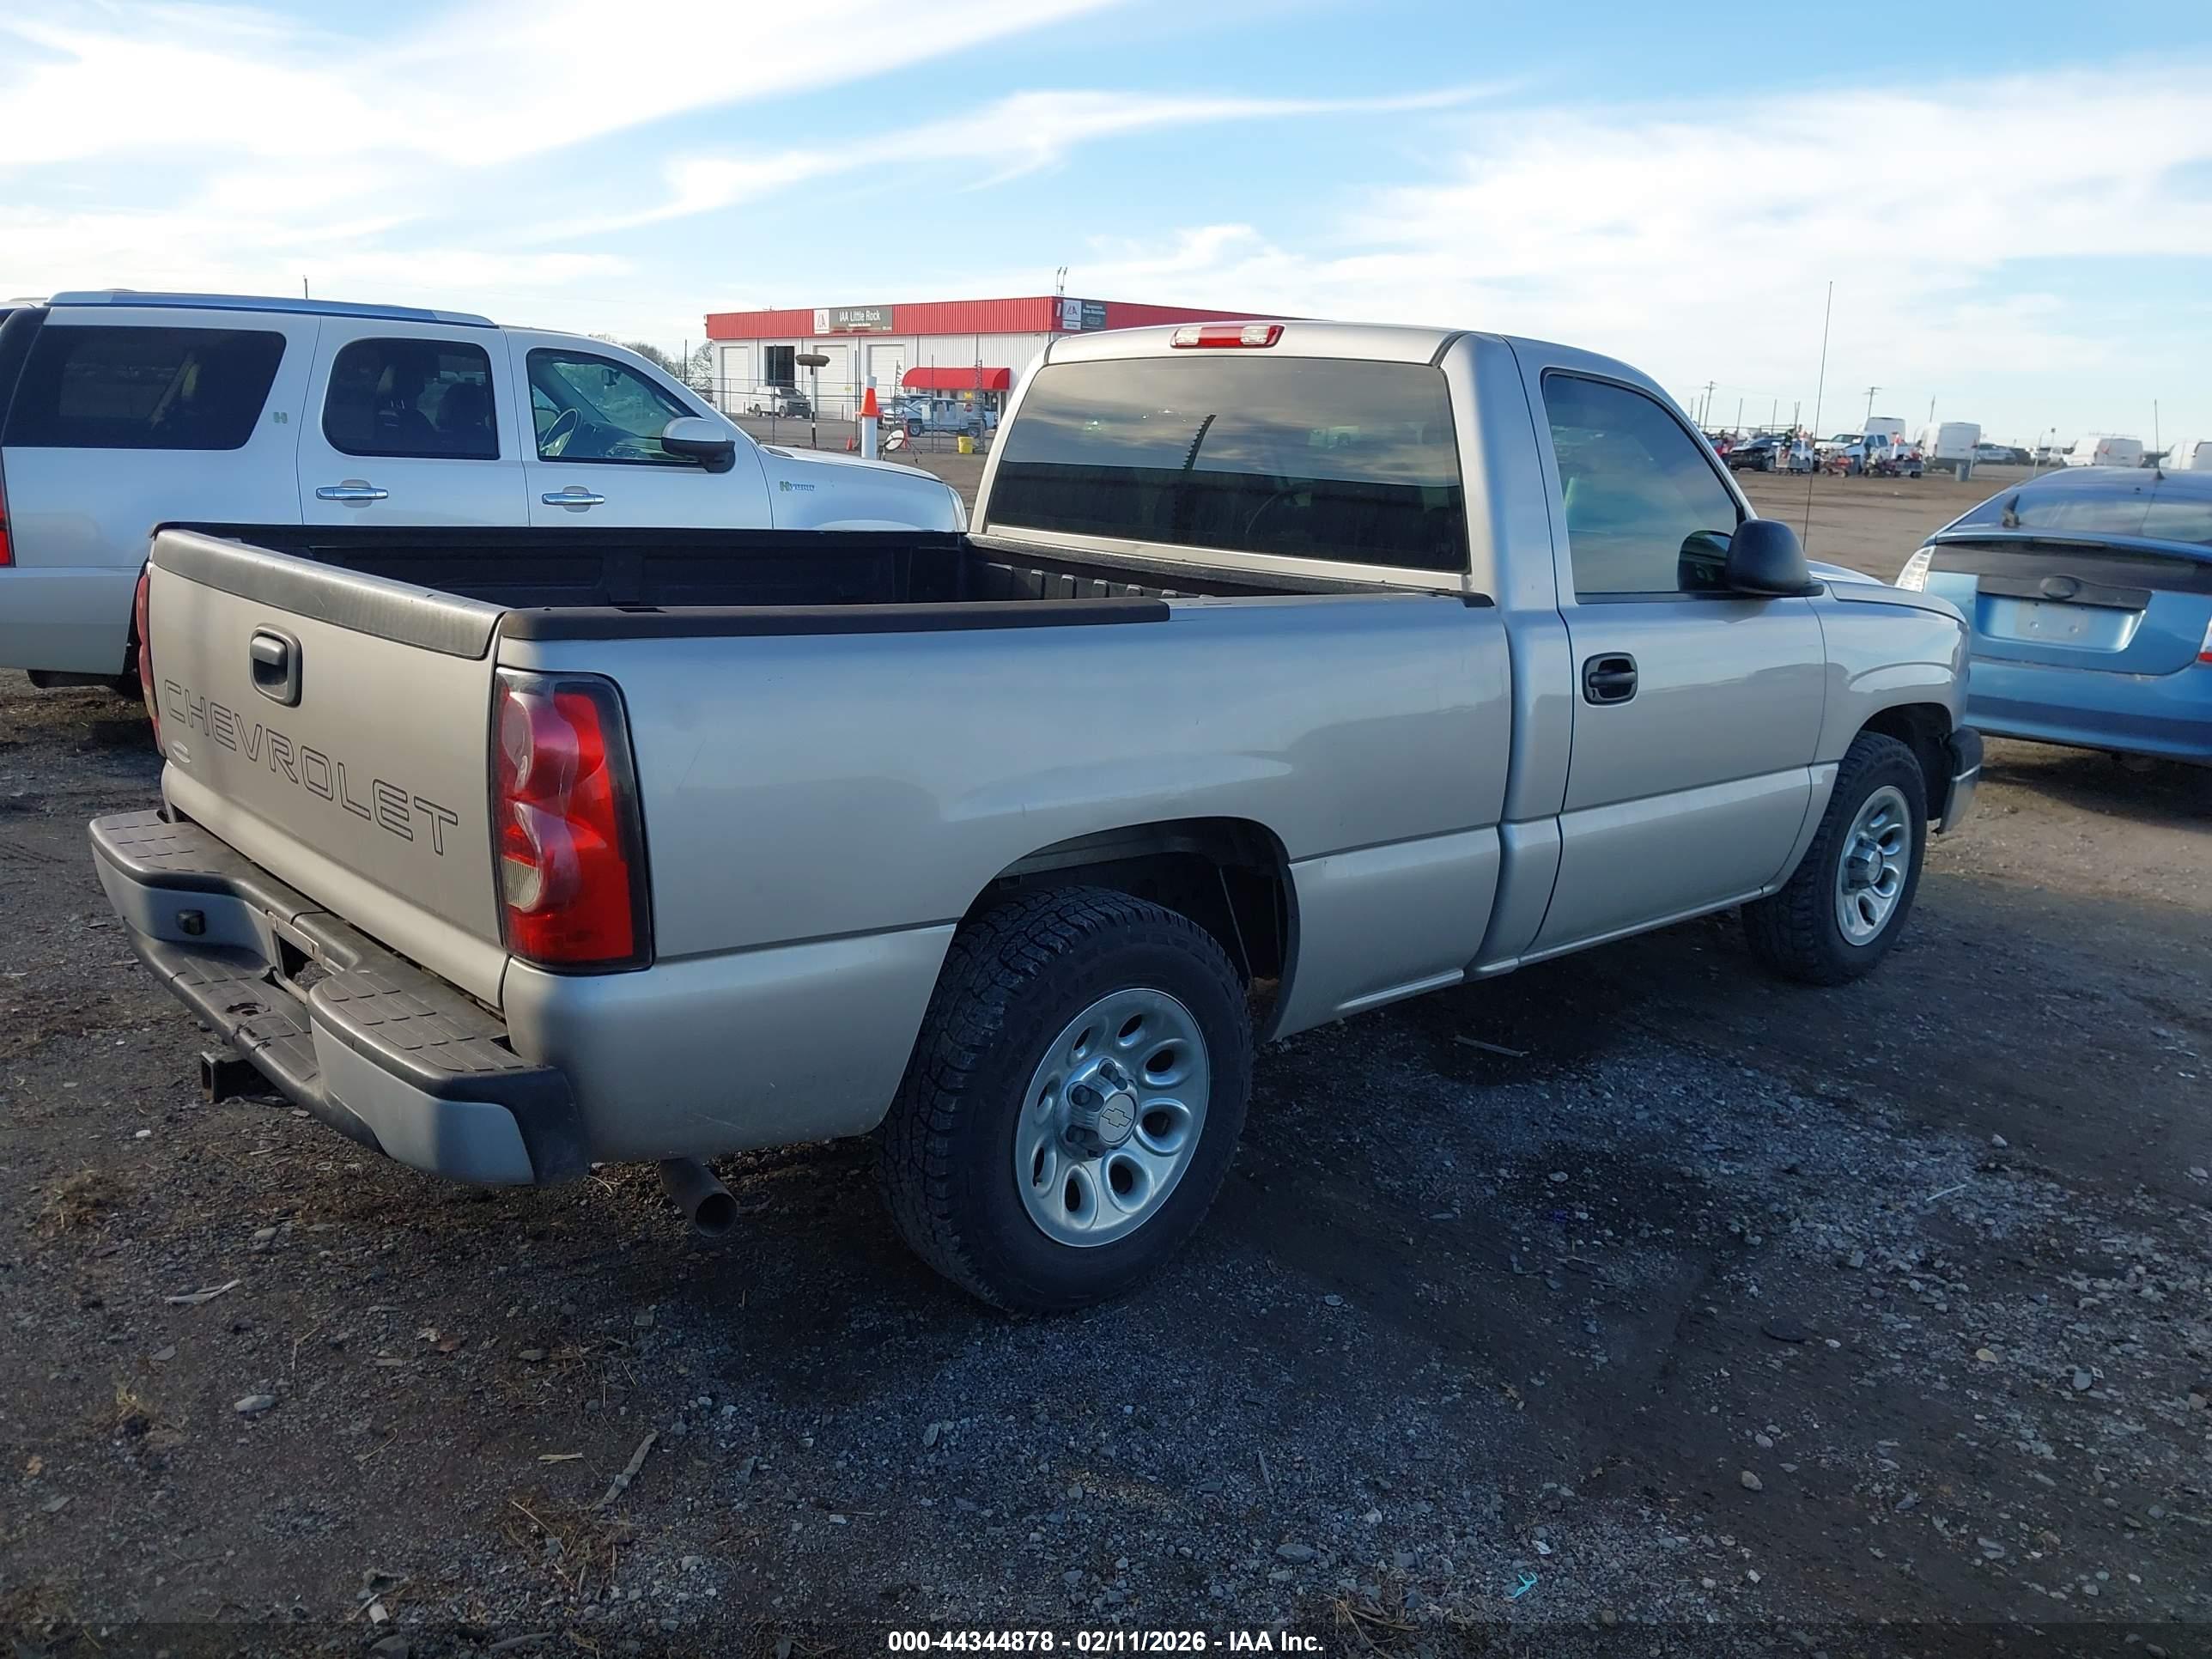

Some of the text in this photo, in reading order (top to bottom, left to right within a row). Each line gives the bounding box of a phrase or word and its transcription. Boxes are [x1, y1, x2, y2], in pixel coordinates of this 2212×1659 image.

[839, 310, 881, 322] IAA Little Rock
[164, 679, 459, 856] CHEVROLET
